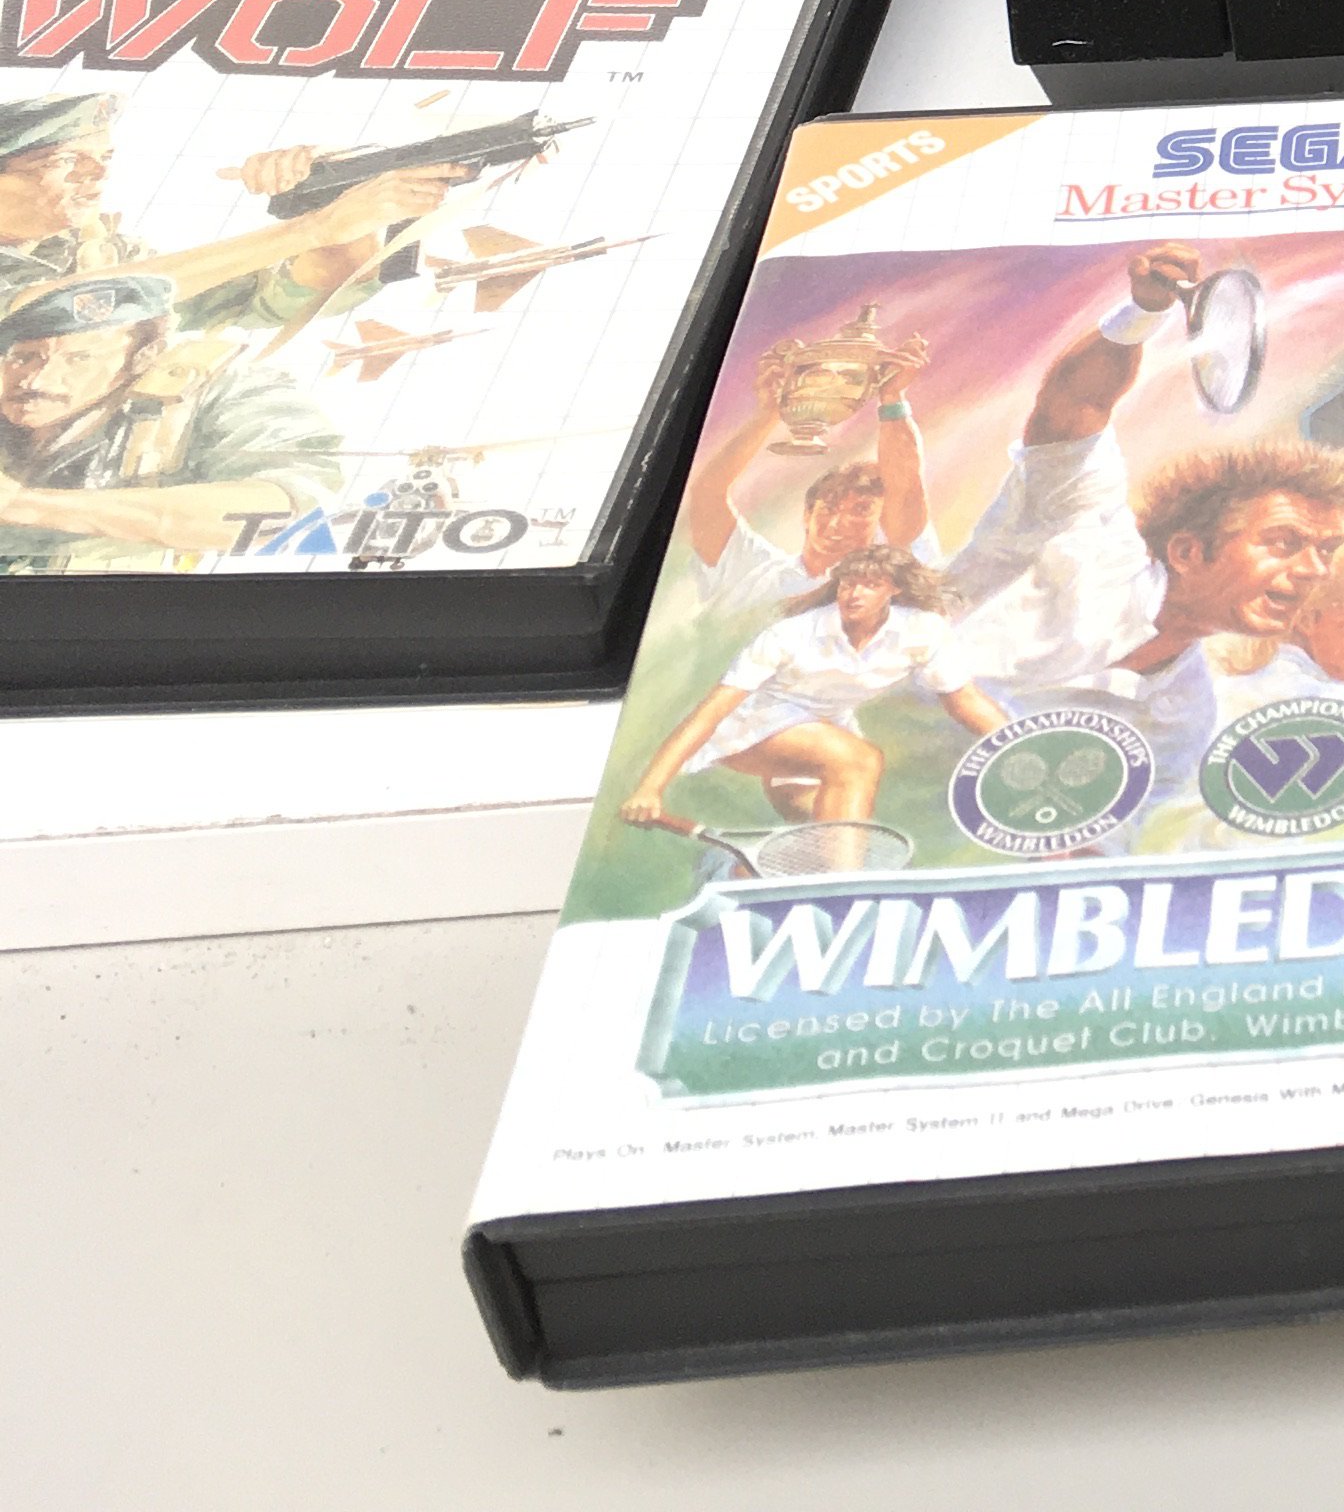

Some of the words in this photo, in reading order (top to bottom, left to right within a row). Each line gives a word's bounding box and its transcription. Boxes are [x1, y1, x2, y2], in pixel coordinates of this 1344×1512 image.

[785, 129, 946, 215] SPORTS
[1056, 182, 1268, 218] Master
[223, 492, 528, 556] TAITO
[961, 749, 990, 776] THE
[992, 709, 1149, 767] CHAMPIONSHIPS
[1208, 737, 1240, 764] THE
[975, 815, 1119, 852] WIMBLEDON
[703, 1000, 903, 1046] Licensed
[919, 997, 969, 1032] by
[991, 993, 1061, 1023] The
[1079, 986, 1132, 1014] All
[1151, 972, 1324, 1021] England
[817, 1035, 901, 1071] and
[920, 1023, 1091, 1067] Croquet
[553, 1148, 606, 1162] Plays
[663, 1137, 730, 1153] Master
[828, 1119, 893, 1137] Master
[906, 1117, 979, 1134] System
[1016, 1109, 1051, 1123] and
[1061, 1103, 1114, 1120] Mega
[1191, 1091, 1269, 1107] Genesis
[1280, 1085, 1322, 1101] With
